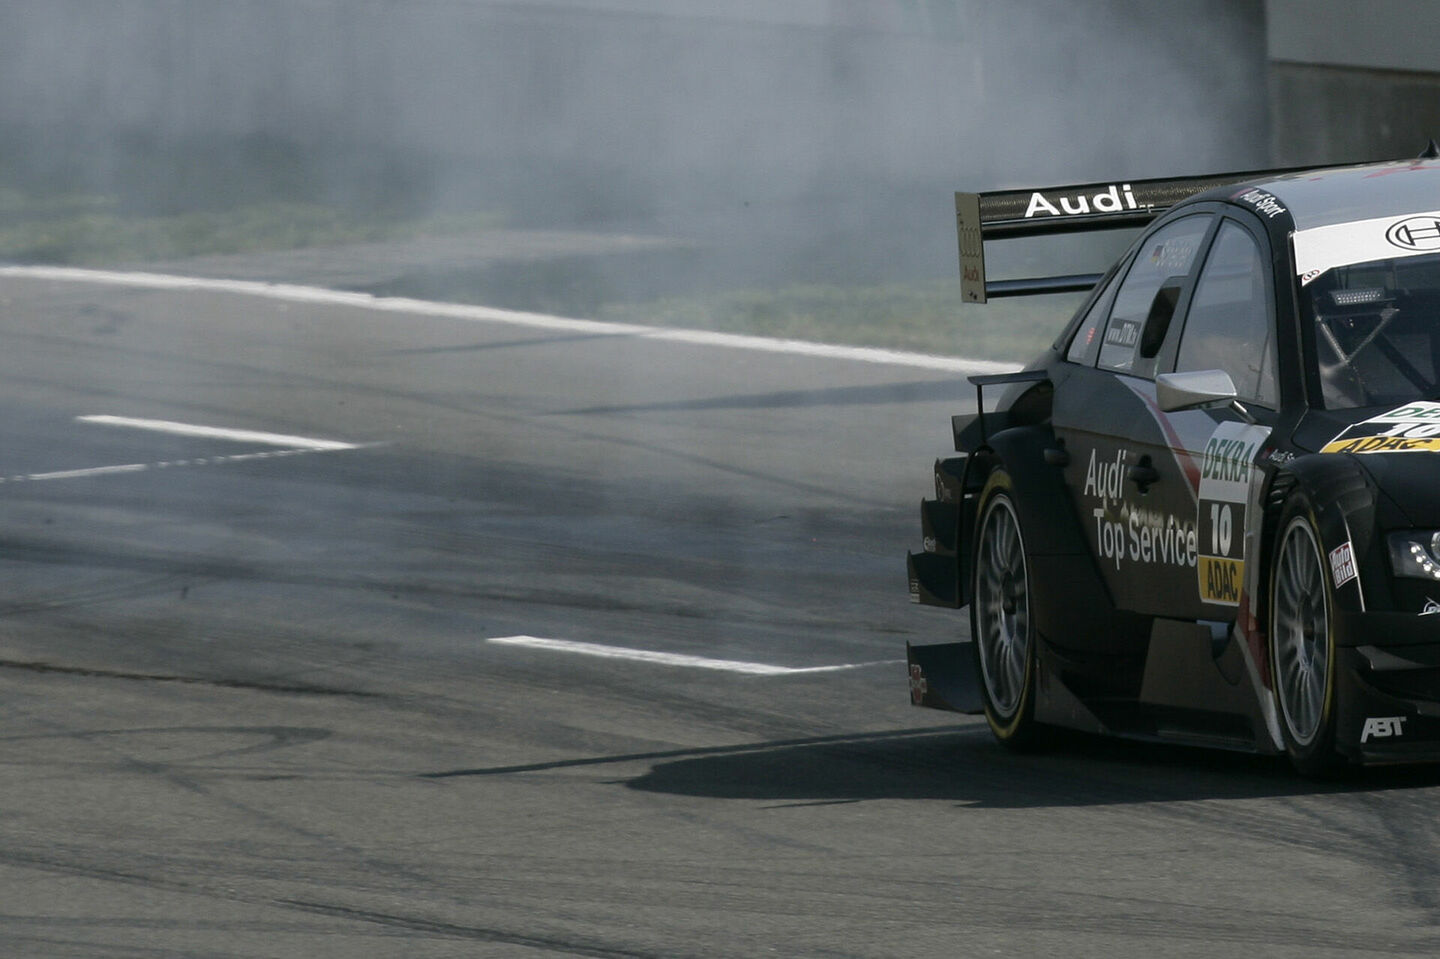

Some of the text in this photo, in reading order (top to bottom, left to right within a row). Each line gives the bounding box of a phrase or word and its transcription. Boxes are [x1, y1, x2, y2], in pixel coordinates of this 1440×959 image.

[1024, 184, 1138, 218] Audi
[1202, 438, 1256, 484] DEKRA
[1339, 436, 1434, 453] ADAC
[1084, 447, 1127, 499] Audi
[1093, 507, 1198, 570] Top Service
[1210, 503, 1233, 556] 10
[1207, 560, 1239, 602] ADAC
[1360, 716, 1407, 743] ABT
